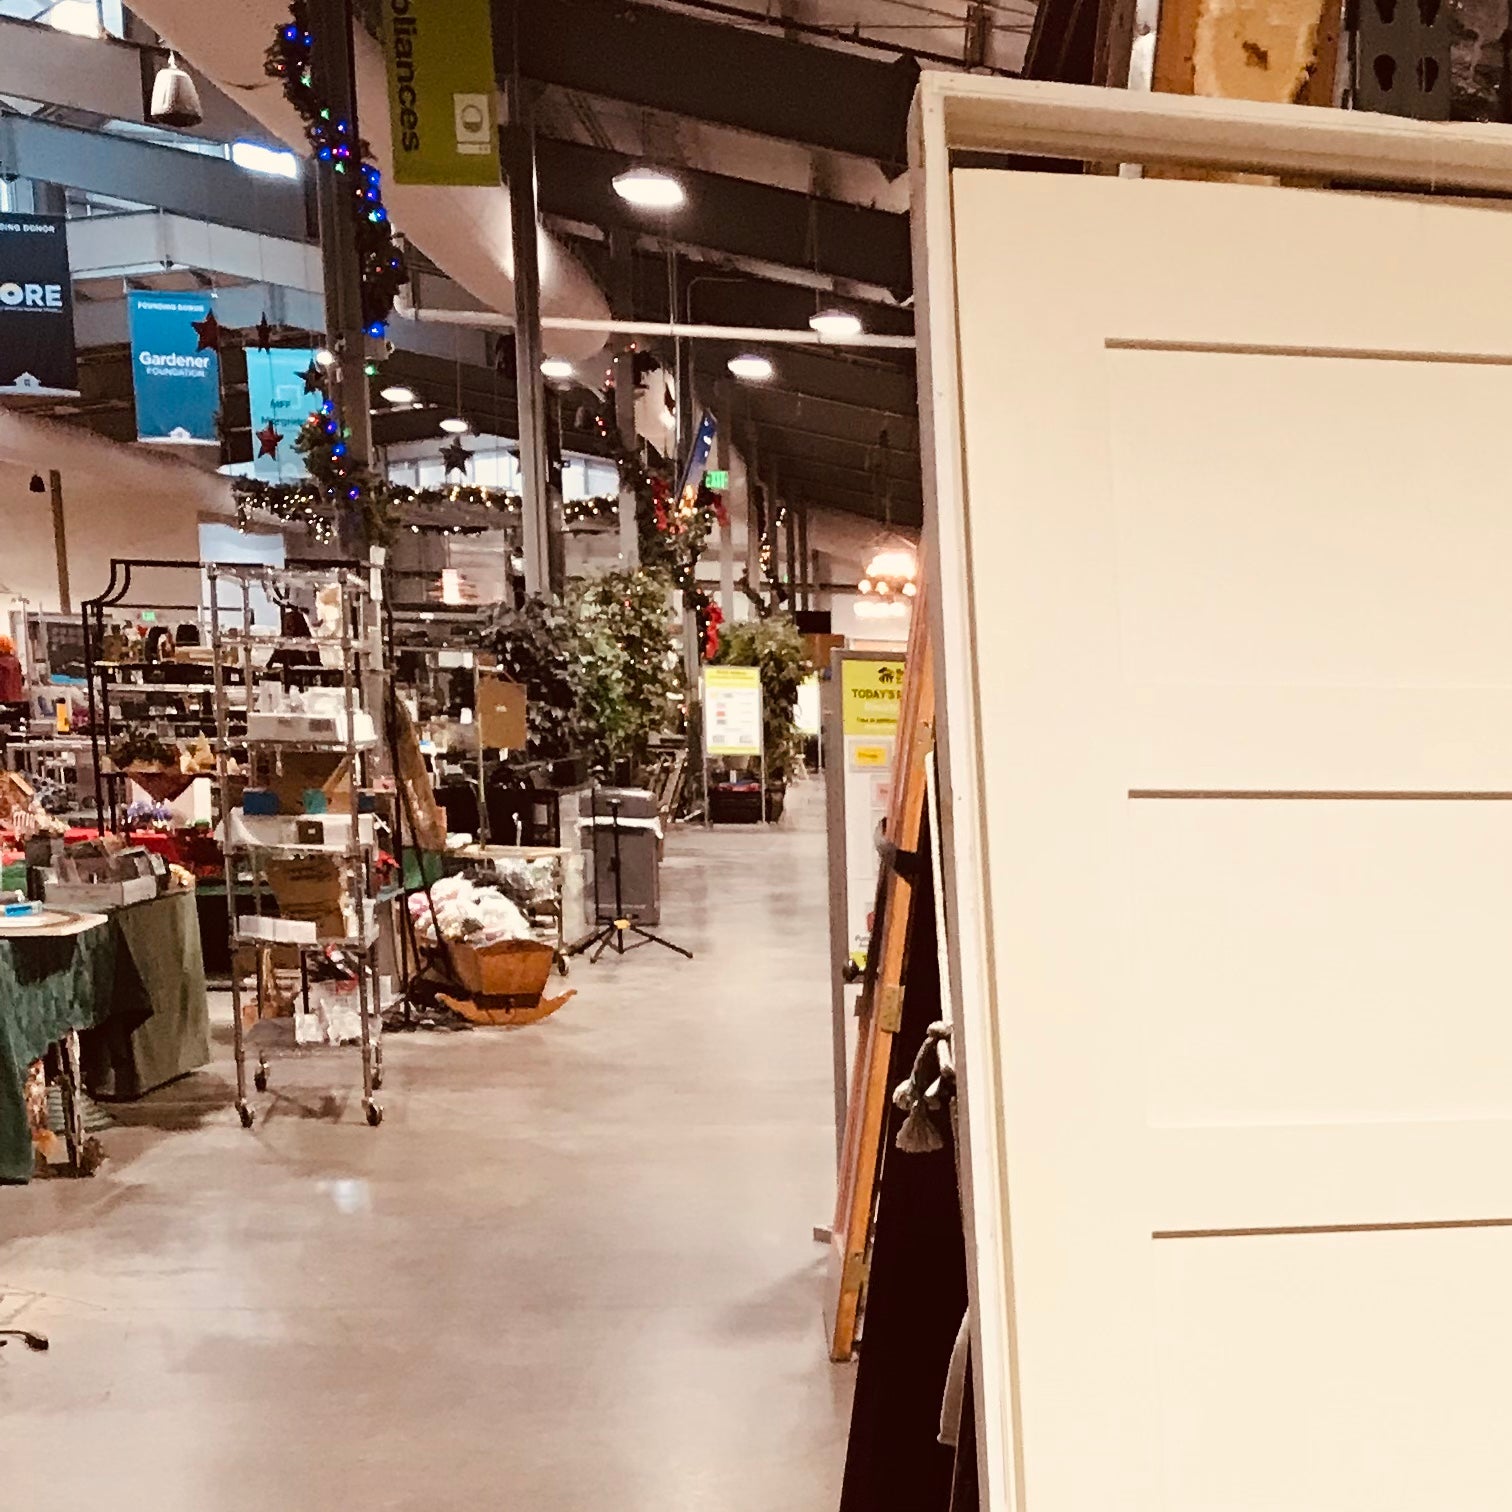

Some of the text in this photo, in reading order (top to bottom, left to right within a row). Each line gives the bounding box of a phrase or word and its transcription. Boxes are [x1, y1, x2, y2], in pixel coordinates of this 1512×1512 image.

[23, 224, 56, 234] DONOR
[0, 282, 63, 308] ORE
[139, 351, 210, 368] Gardener
